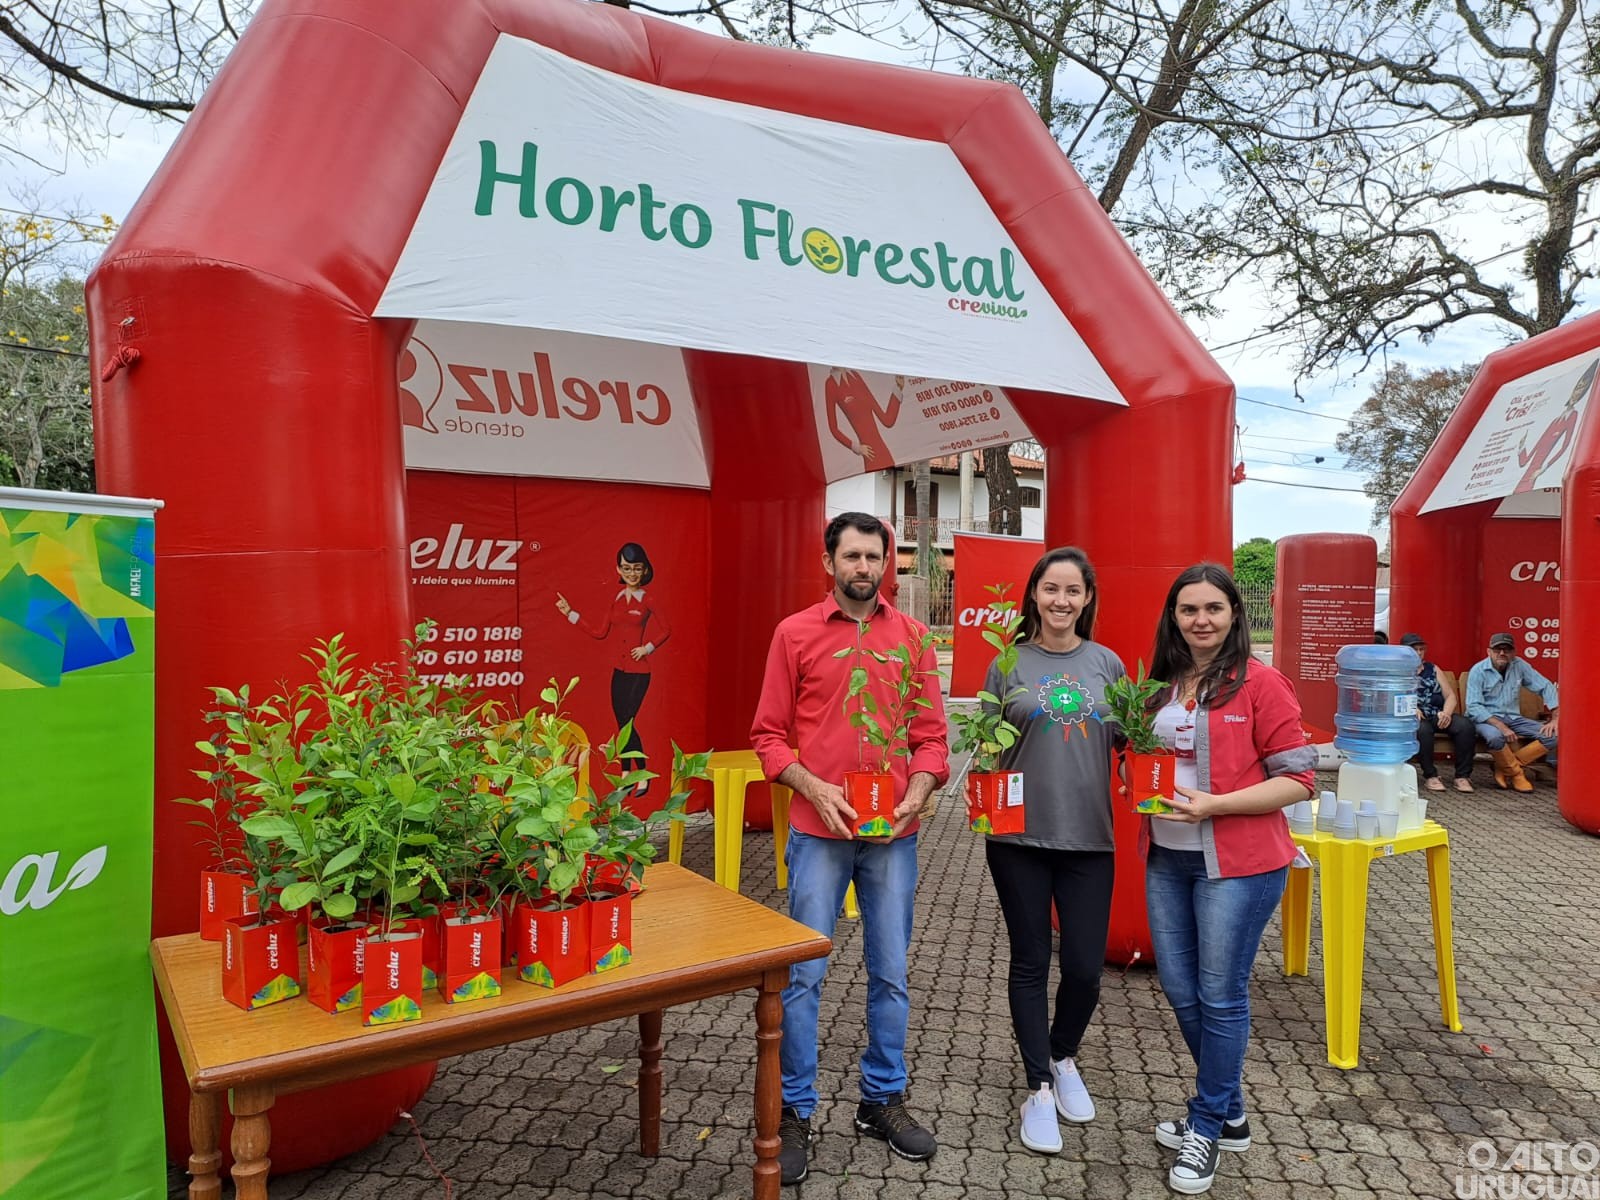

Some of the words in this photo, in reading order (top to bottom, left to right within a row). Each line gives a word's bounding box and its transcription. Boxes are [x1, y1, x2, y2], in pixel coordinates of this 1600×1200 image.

[474, 140, 713, 249] Horto
[737, 198, 1025, 302] Florestal
[948, 298, 1026, 319] creviva
[129, 568, 141, 597] RAFAEL
[420, 575, 448, 585] ideia
[451, 577, 472, 586] que
[475, 576, 516, 585] ilumina
[443, 627, 478, 642] 510
[483, 626, 523, 641] 1818
[443, 650, 479, 665] 610
[484, 649, 523, 663] 1818
[1152, 761, 1161, 790] creluz
[871, 782, 880, 811] creluz
[530, 918, 538, 954] creluz
[610, 906, 619, 939] creluz
[266, 932, 278, 970] creluz
[470, 931, 482, 967] creluz
[389, 950, 400, 990] creluz
